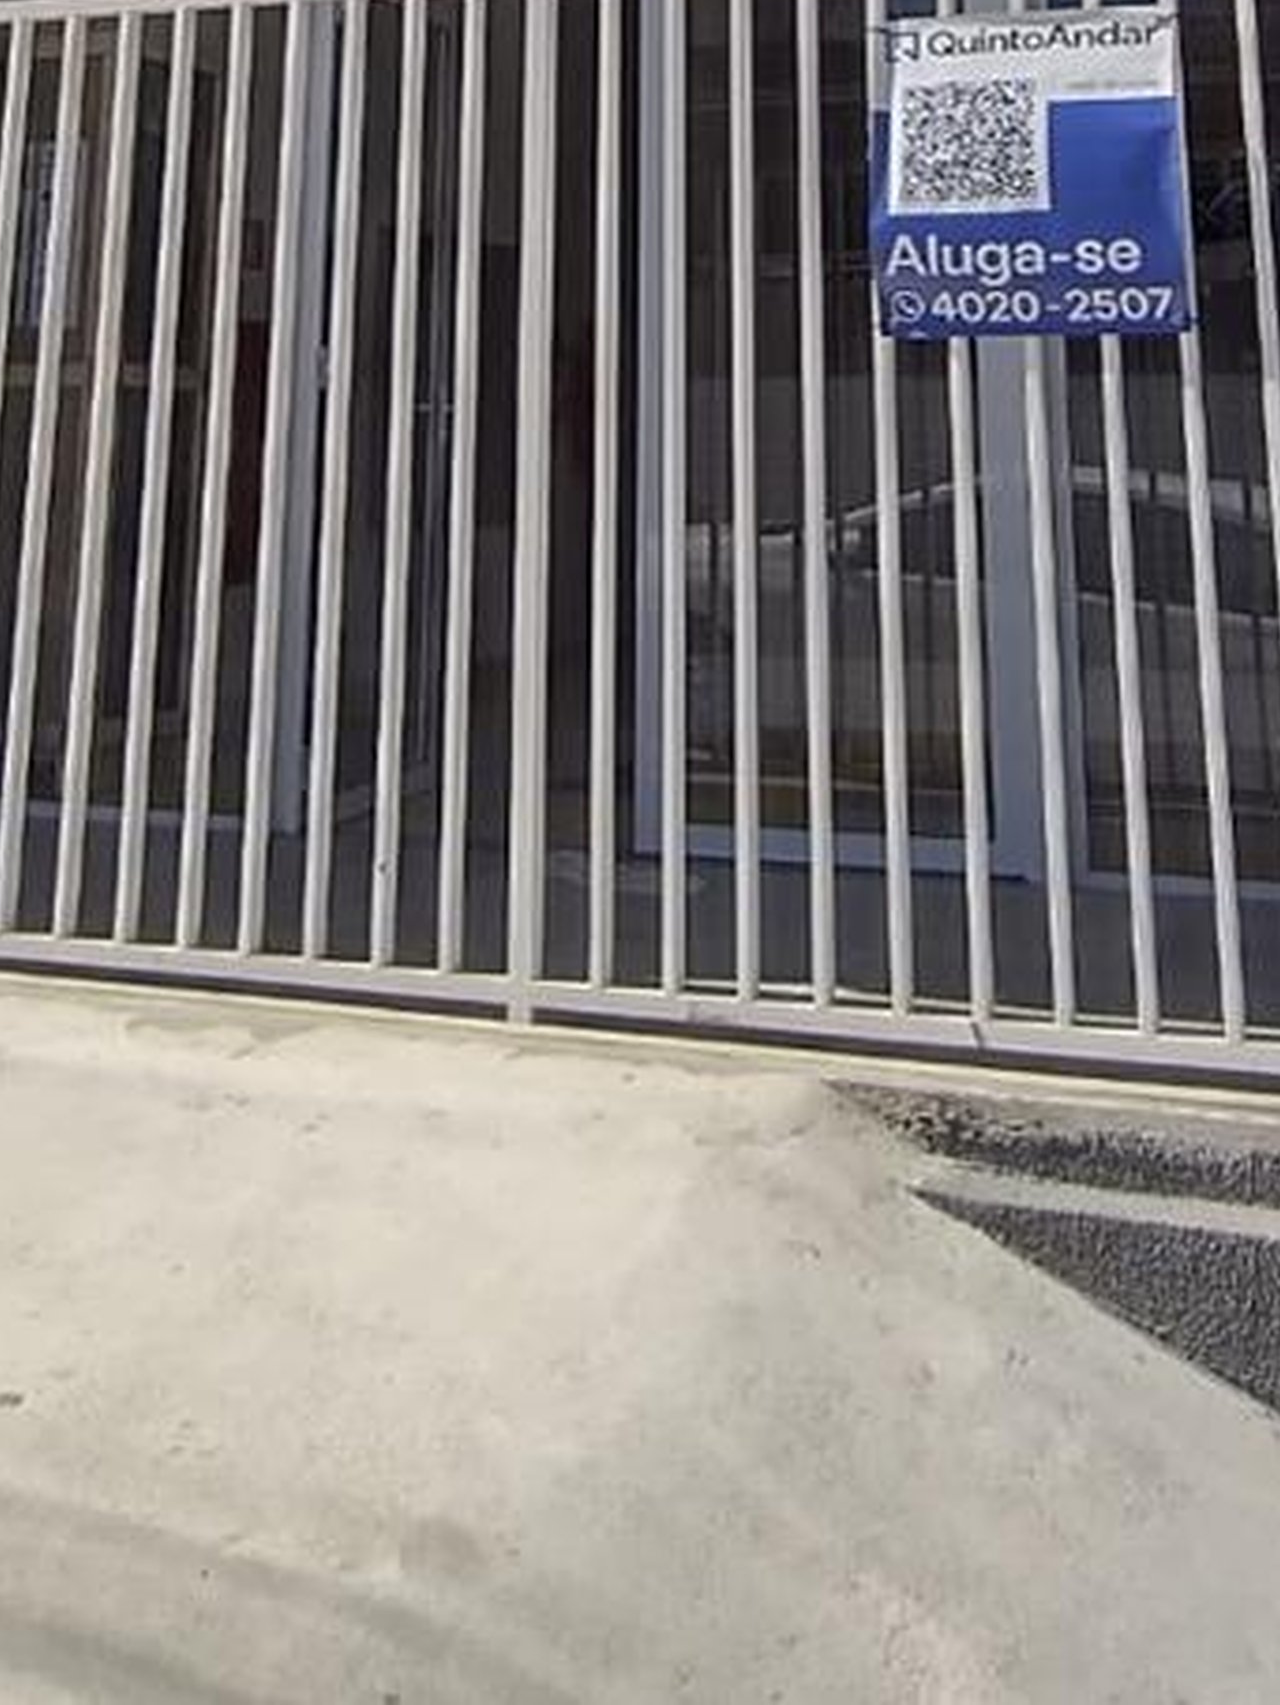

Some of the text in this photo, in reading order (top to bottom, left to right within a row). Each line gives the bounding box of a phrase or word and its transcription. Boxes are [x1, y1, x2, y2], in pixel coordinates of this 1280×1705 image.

[926, 20, 1156, 57] QuintoAndar
[885, 235, 1142, 285] Aluga-se
[931, 290, 1173, 323] 4020-2507
